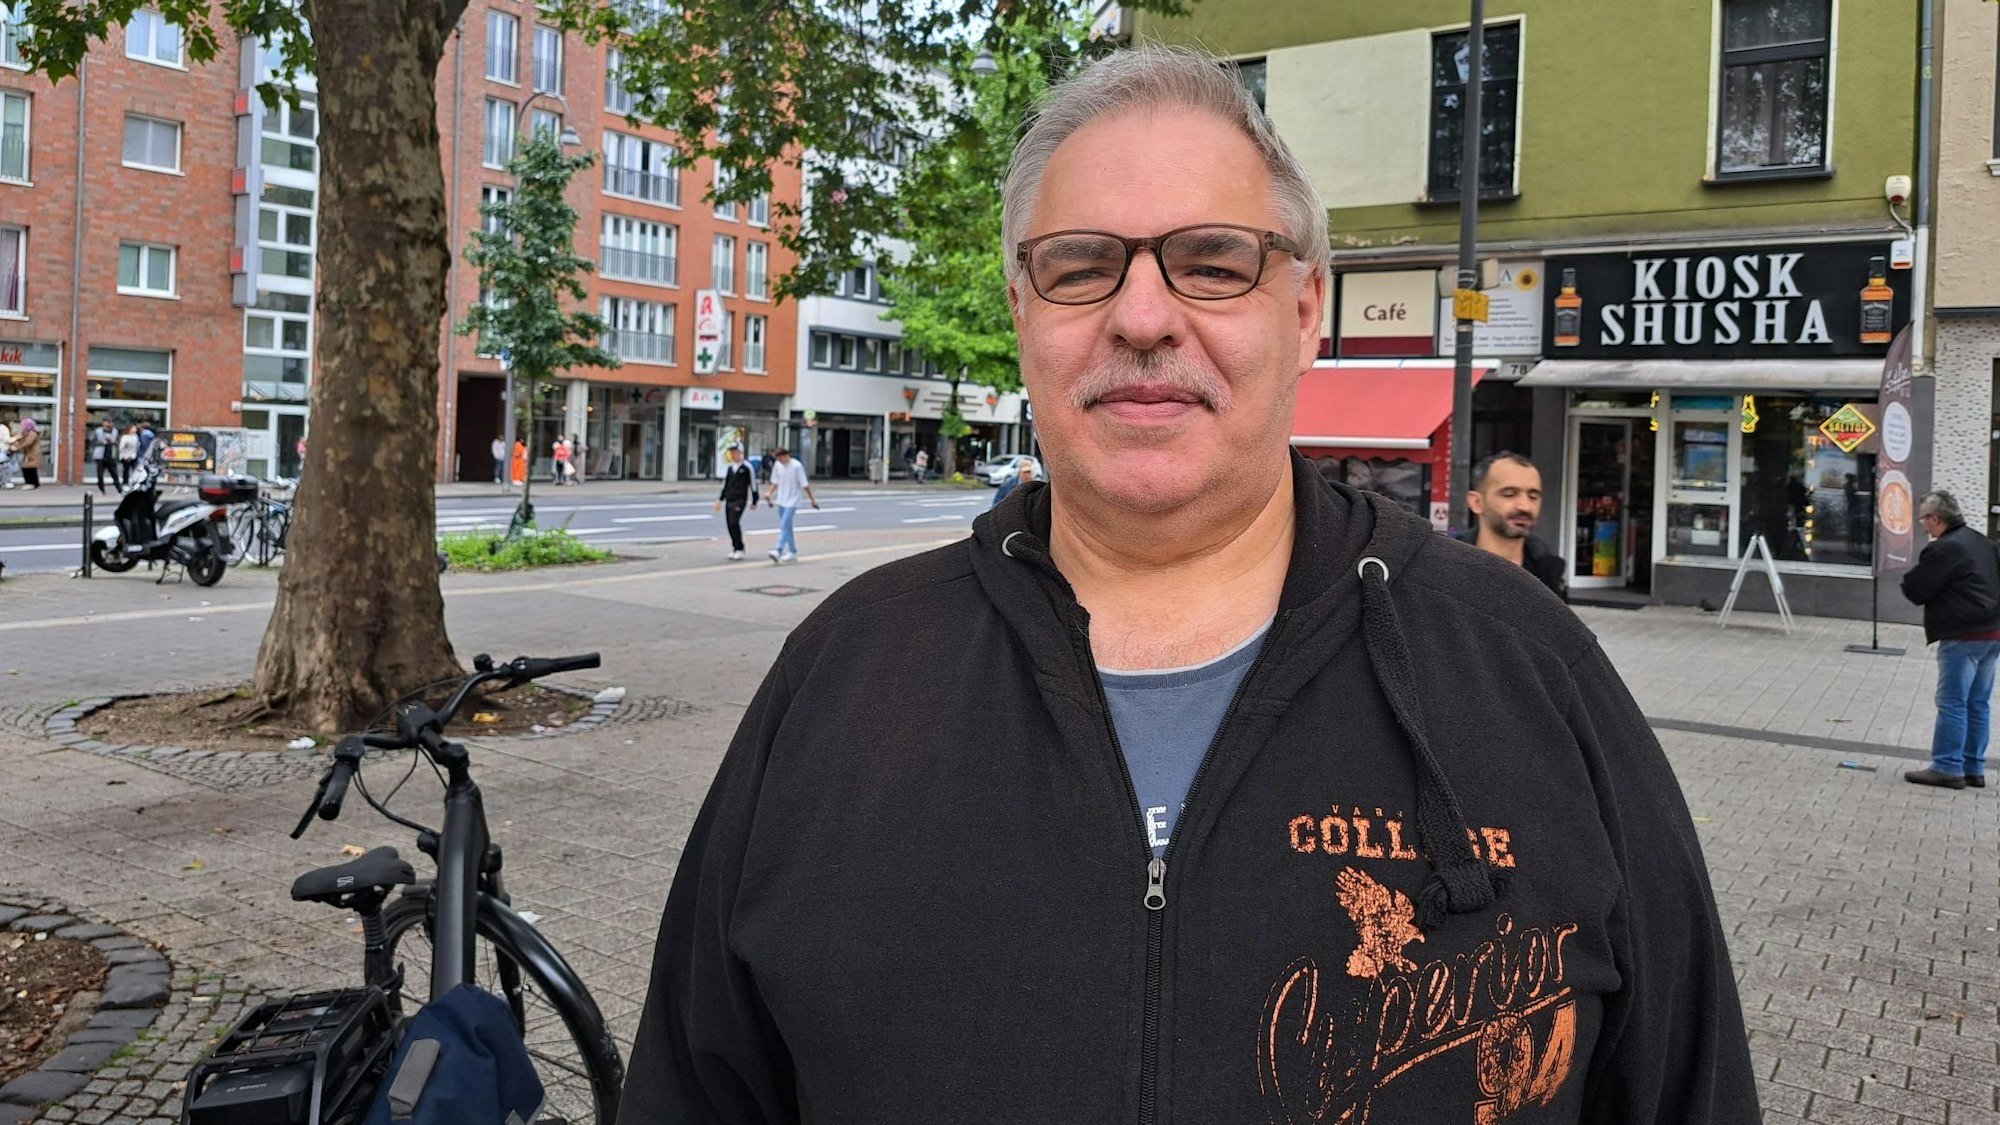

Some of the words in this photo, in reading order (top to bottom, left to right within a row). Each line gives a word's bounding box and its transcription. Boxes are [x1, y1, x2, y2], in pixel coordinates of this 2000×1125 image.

[1631, 253, 1804, 301] KIOSK
[1363, 302, 1407, 322] Café
[1600, 299, 1834, 346] SHUSHA
[1510, 364, 1528, 376] 78
[1331, 804, 1404, 819] VARS
[1289, 813, 1516, 868] COLLE
[1474, 1000, 1576, 1125] 94
